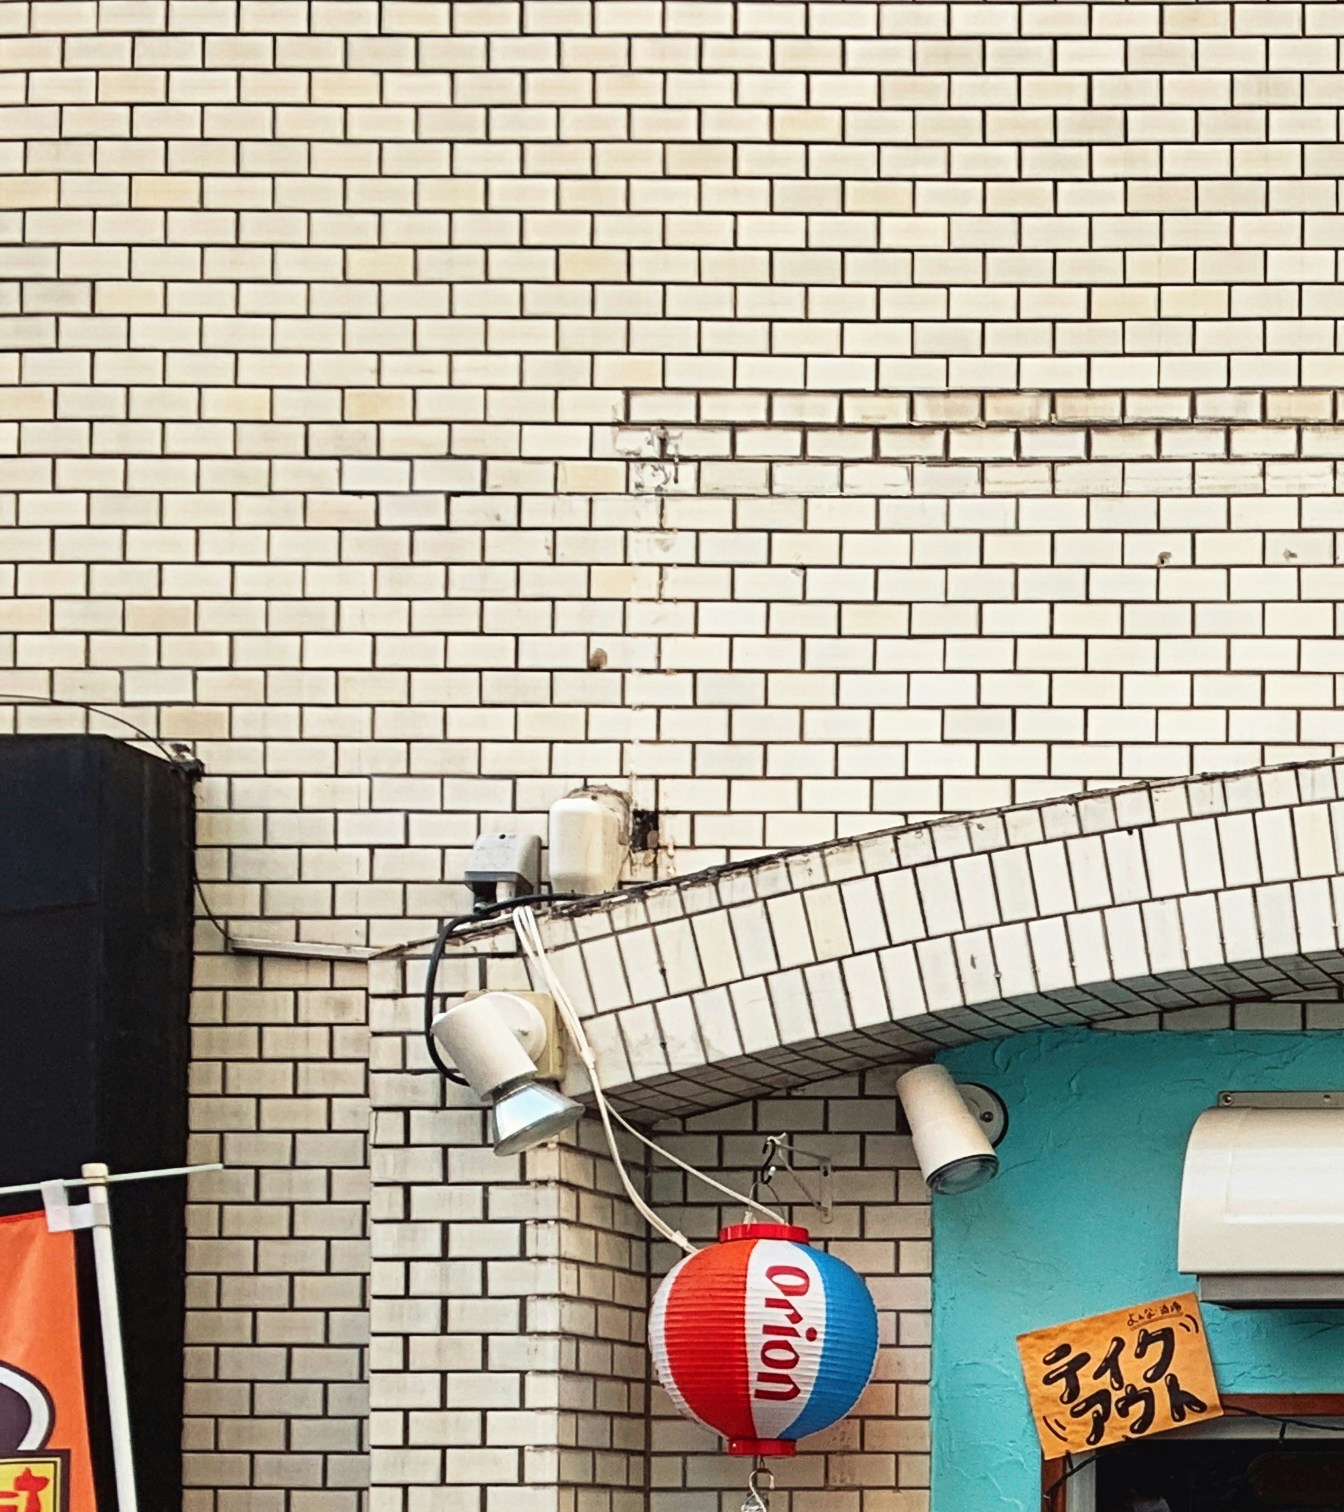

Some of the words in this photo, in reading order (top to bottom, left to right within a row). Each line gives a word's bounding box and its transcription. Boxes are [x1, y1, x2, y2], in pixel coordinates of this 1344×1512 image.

[1042, 1327, 1175, 1405] テイク
[1070, 1373, 1208, 1446] アウト
